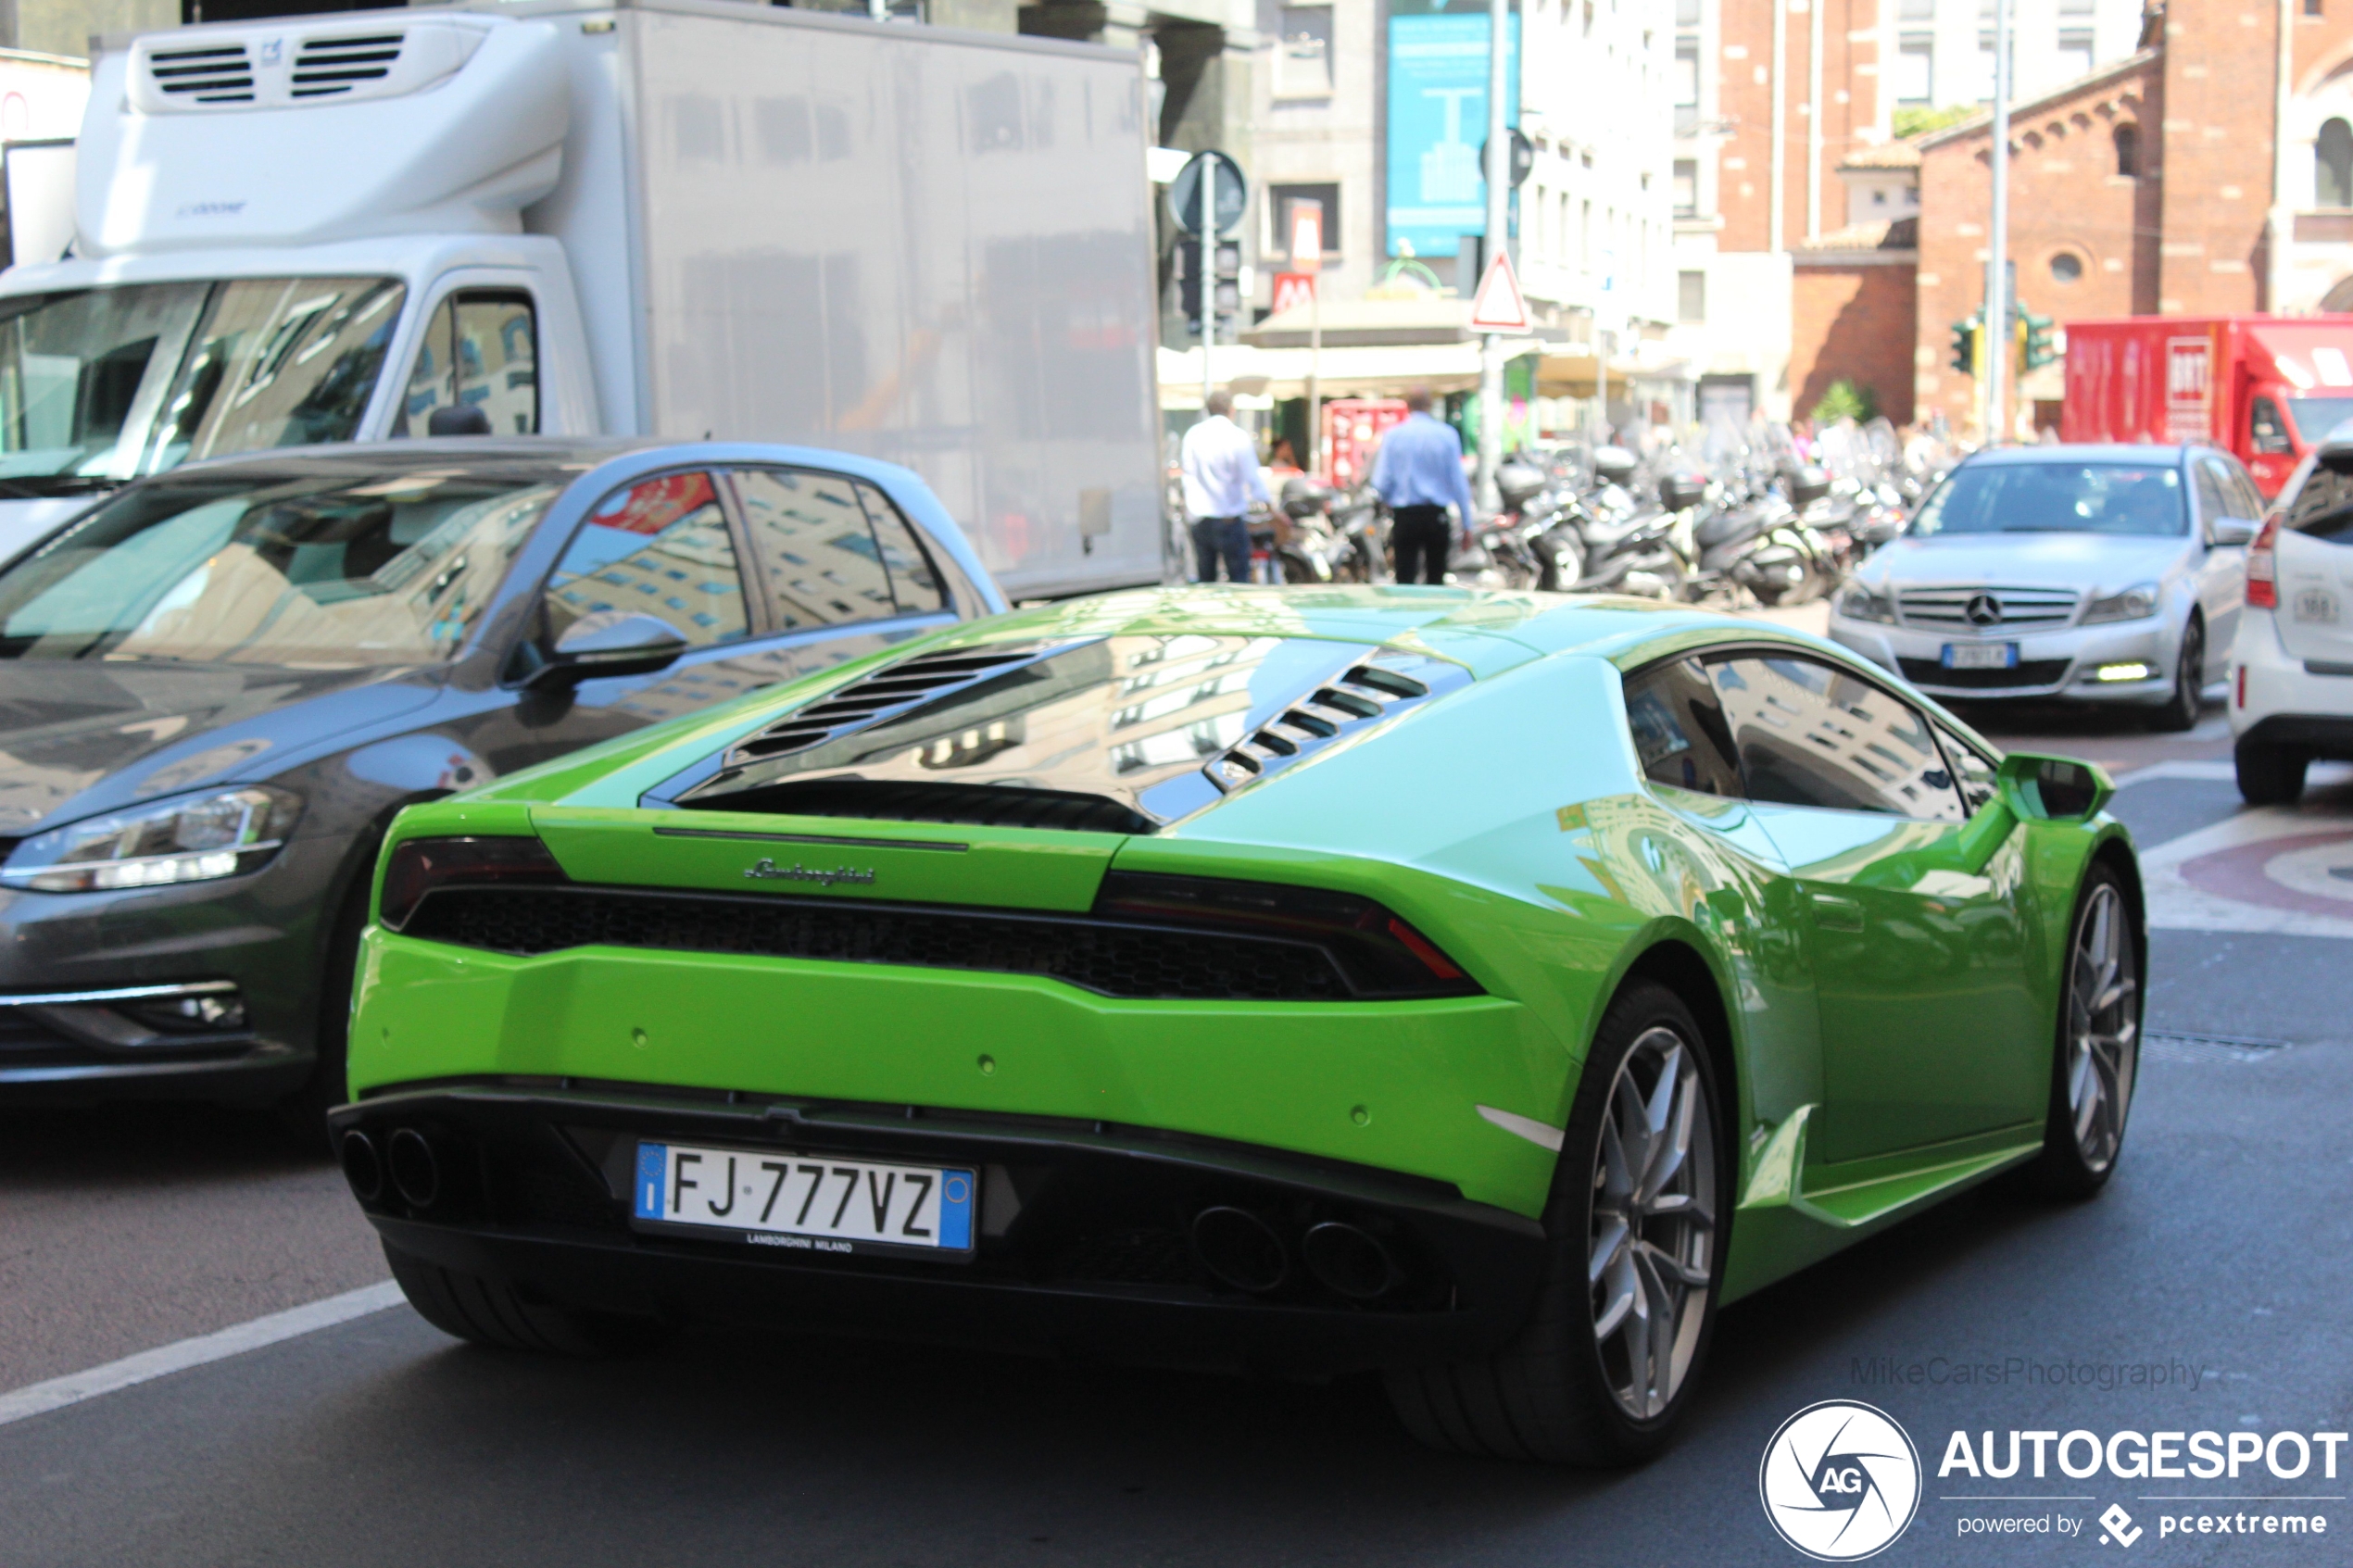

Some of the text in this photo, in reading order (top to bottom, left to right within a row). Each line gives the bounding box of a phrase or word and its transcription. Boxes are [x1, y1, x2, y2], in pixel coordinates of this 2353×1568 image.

[2171, 352, 2208, 393] BRT
[744, 858, 875, 886] Lamborghini
[747, 1234, 852, 1253] LAMBORGHINI MILANO
